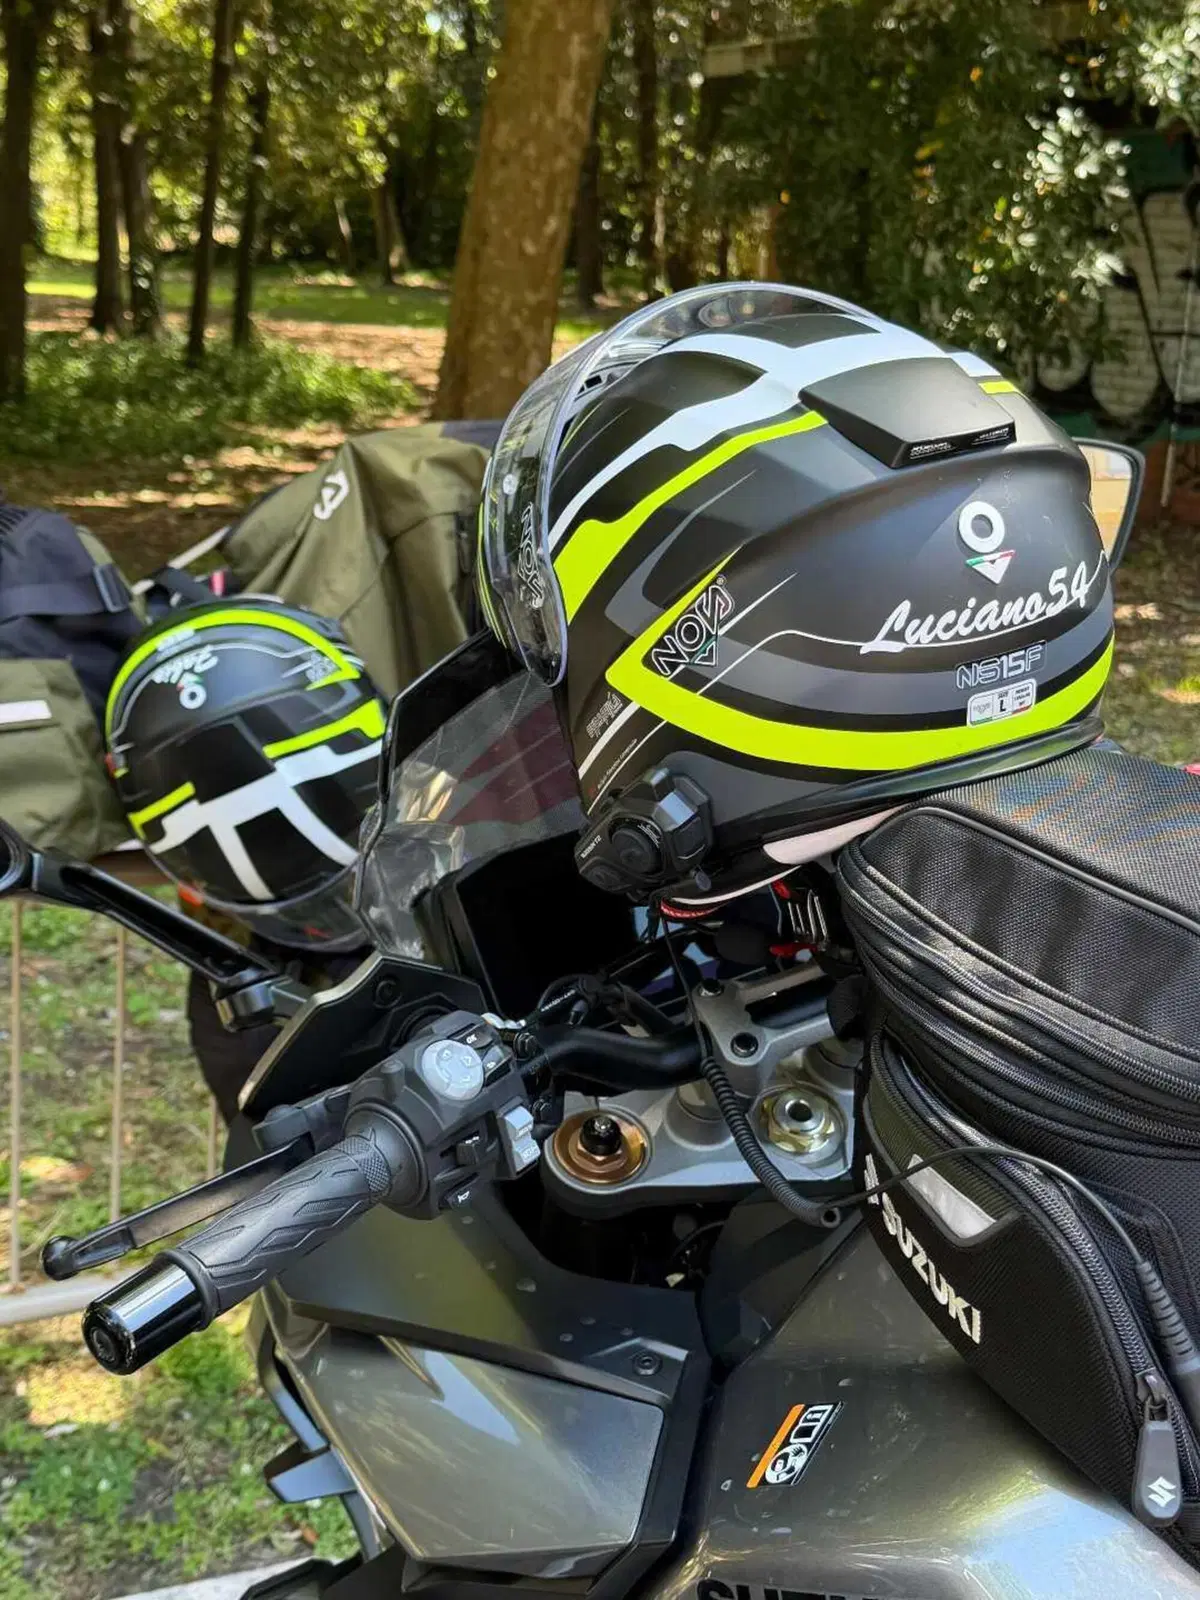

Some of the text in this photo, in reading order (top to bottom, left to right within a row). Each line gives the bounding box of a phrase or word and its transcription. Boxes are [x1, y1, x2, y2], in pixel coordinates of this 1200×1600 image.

[651, 584, 734, 676] NOS
[956, 644, 1044, 689] NS15F
[881, 1191, 981, 1344] SUZUKI
